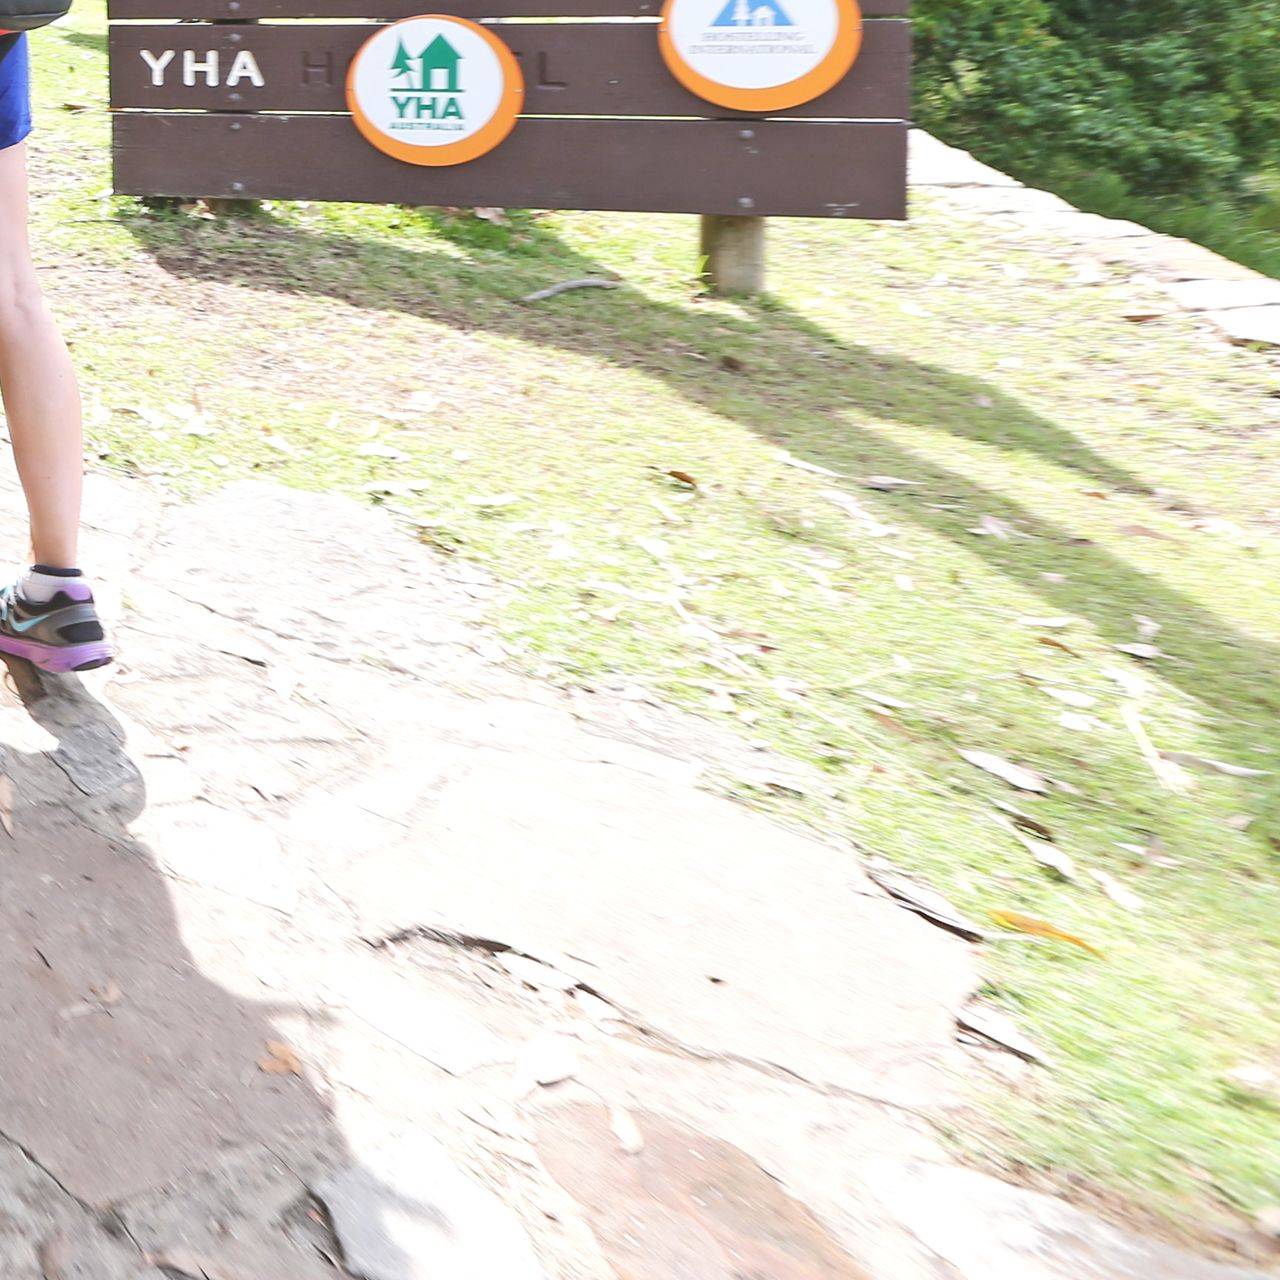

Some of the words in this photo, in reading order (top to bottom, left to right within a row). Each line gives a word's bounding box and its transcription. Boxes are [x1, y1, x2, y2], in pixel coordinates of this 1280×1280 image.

[140, 49, 265, 87] YHA
[388, 95, 465, 120] YHA
[389, 122, 465, 131] AUSTRALIA
